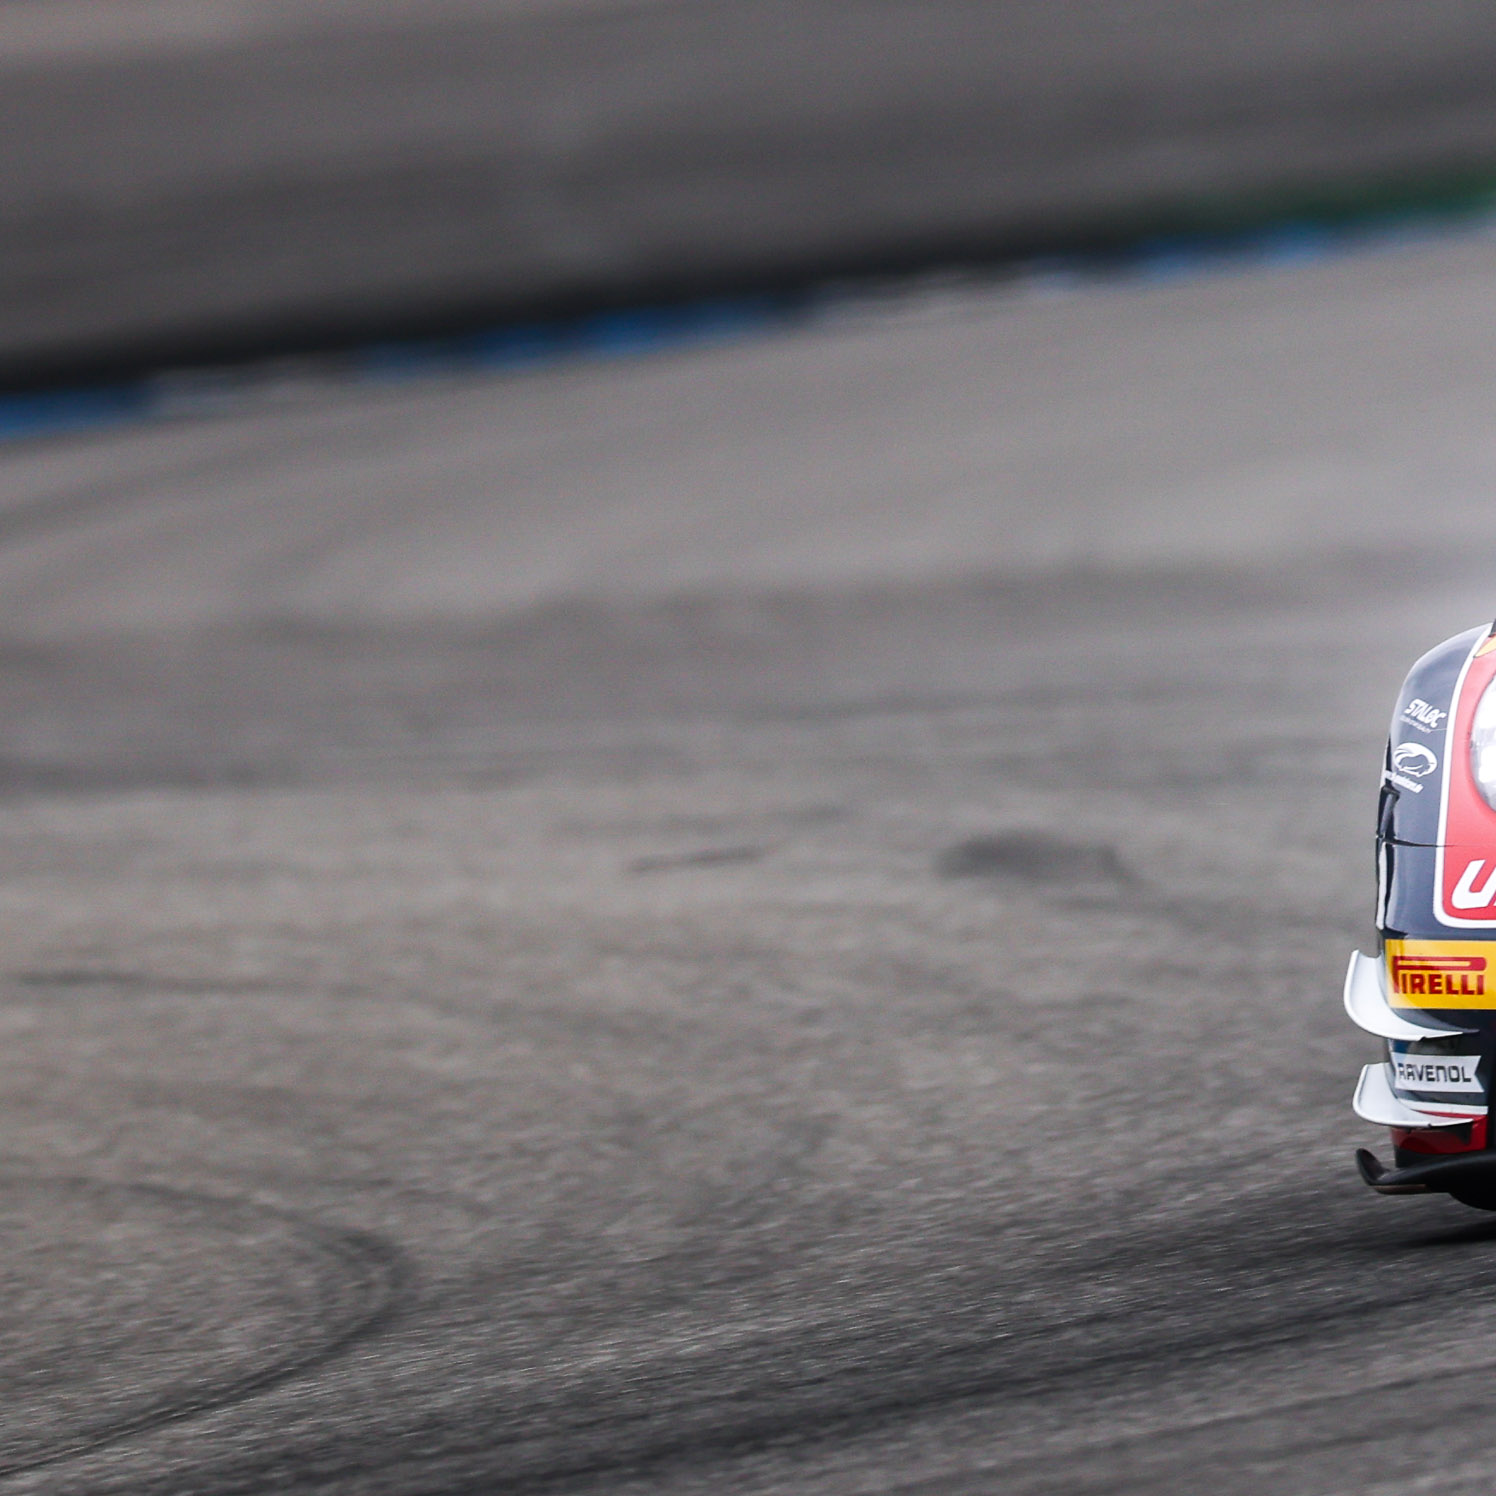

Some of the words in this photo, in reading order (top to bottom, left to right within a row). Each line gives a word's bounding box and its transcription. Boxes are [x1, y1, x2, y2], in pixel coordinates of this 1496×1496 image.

[1403, 697, 1448, 729] STALOC
[1391, 955, 1488, 996] PIRELLI
[1397, 1062, 1472, 1083] RAVENOL
